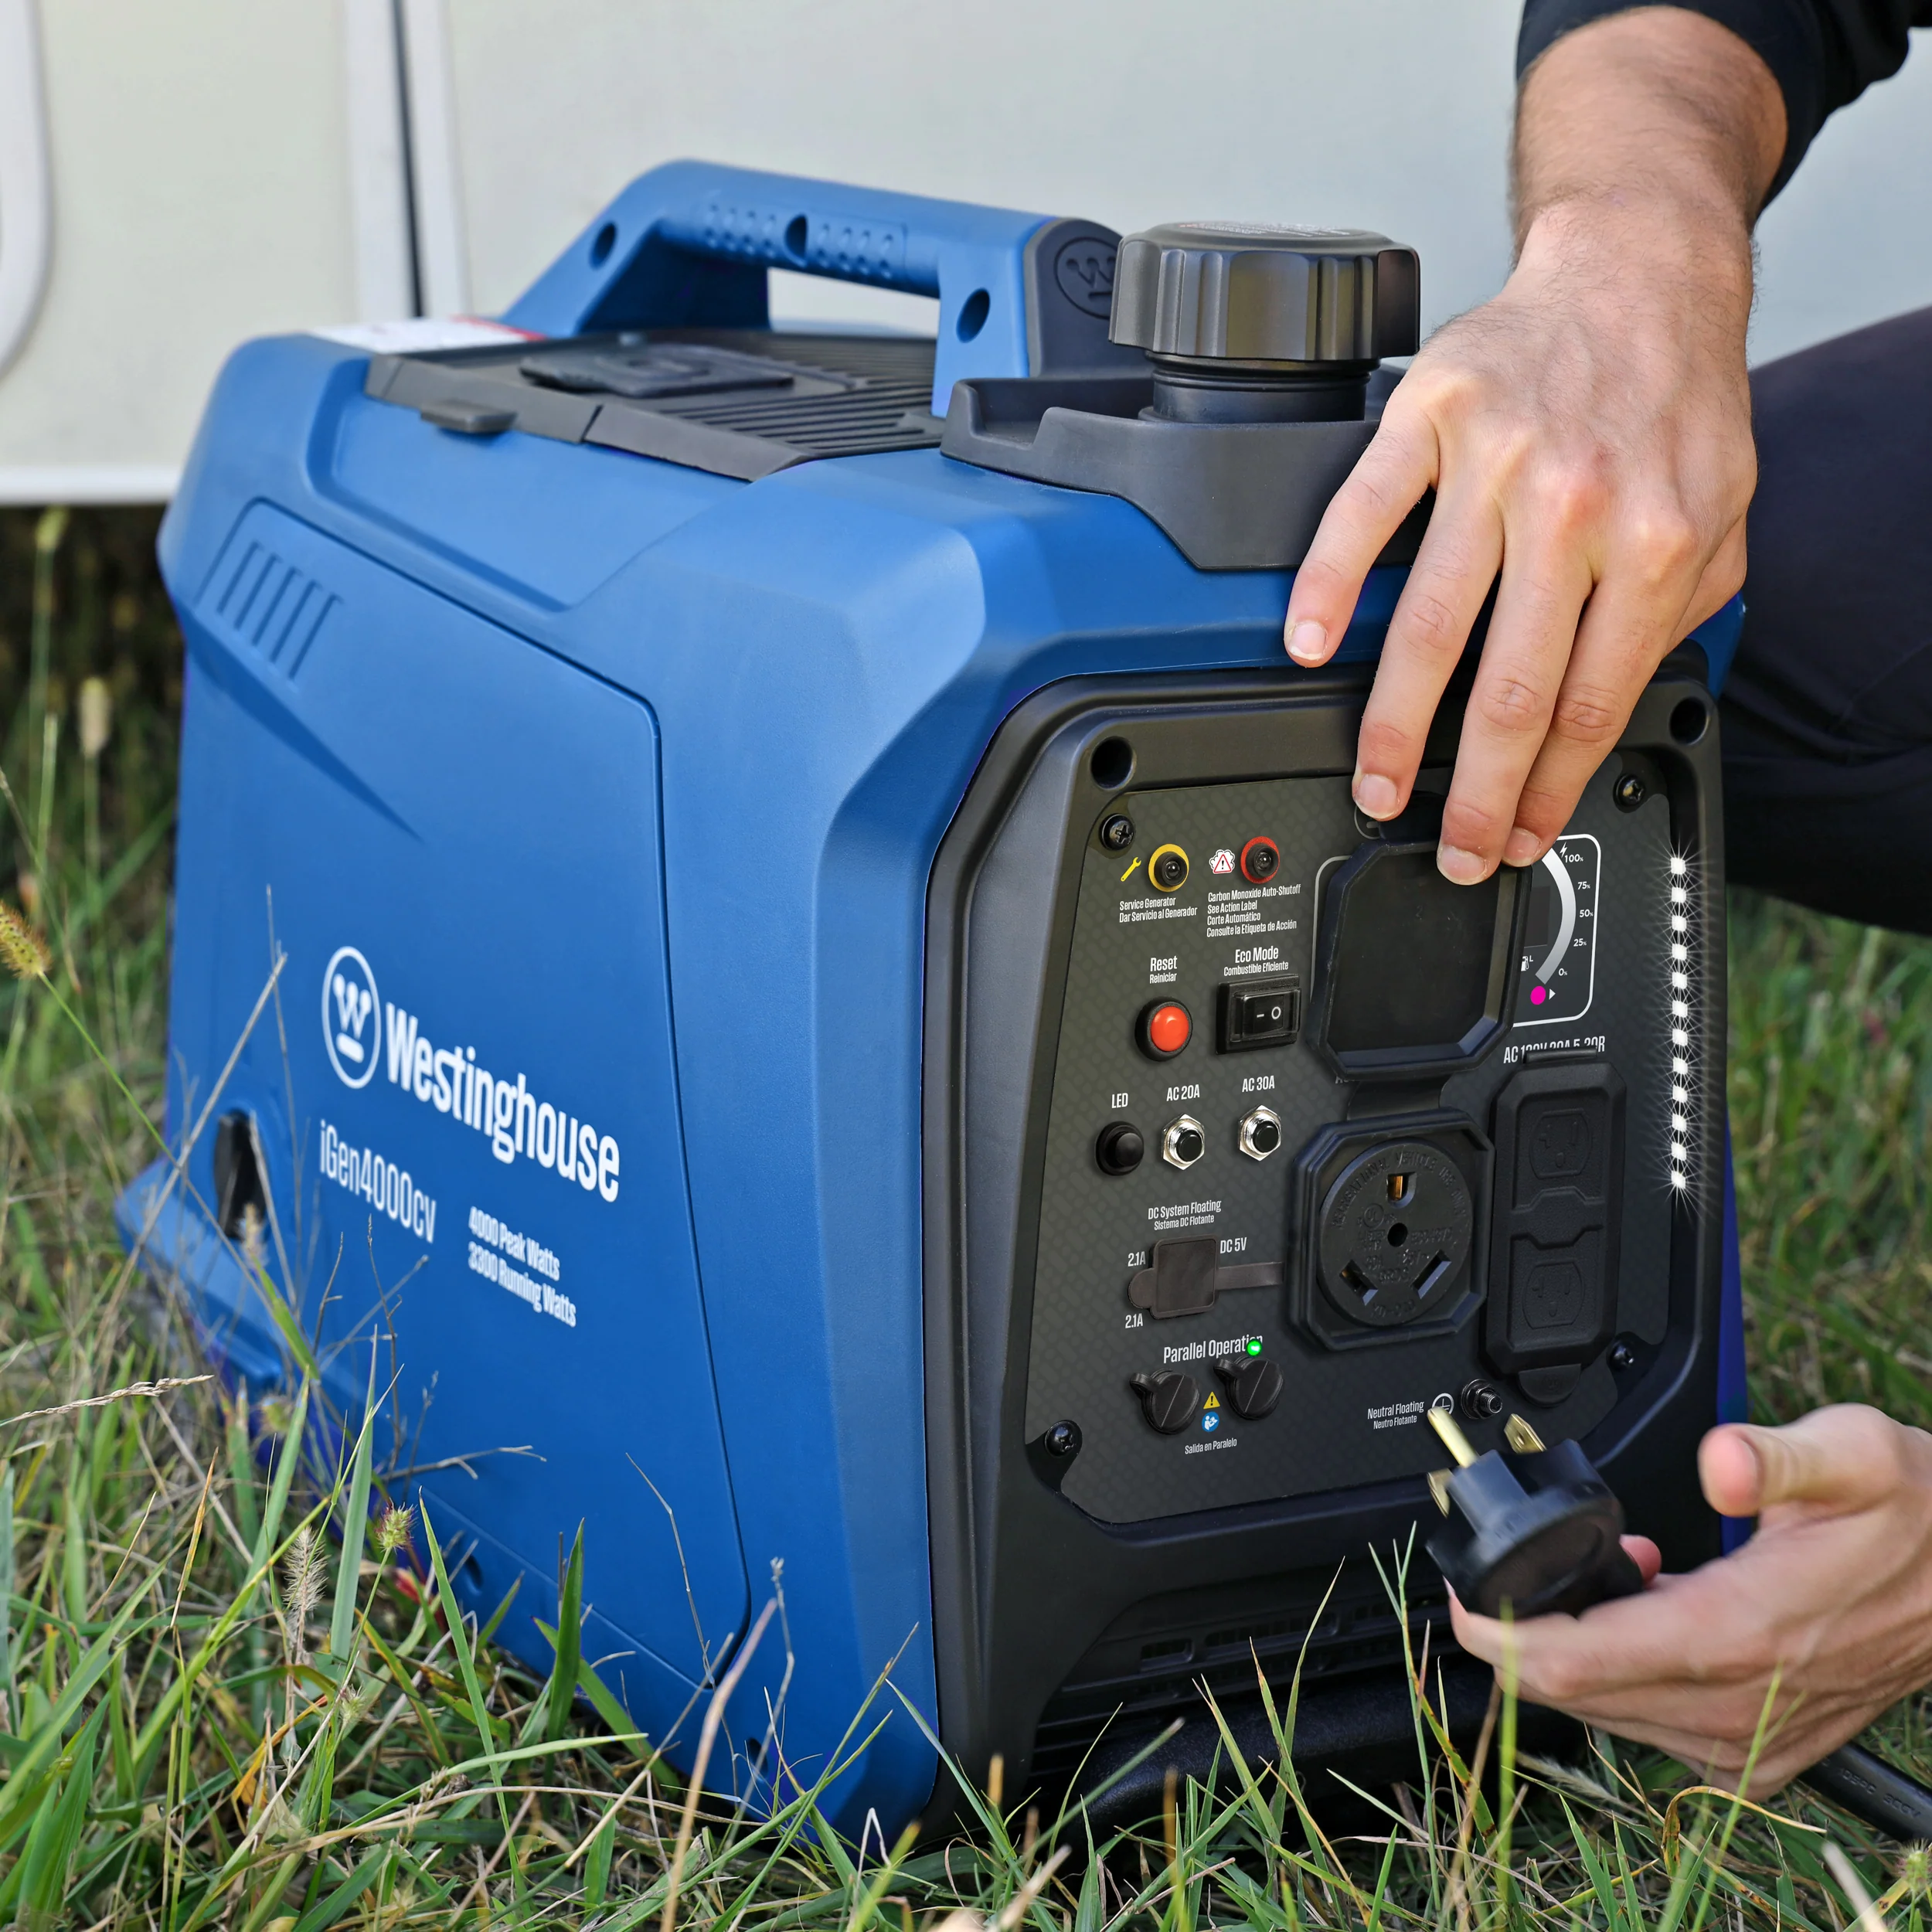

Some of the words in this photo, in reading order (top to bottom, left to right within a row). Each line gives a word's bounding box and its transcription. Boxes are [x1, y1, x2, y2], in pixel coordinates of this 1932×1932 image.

[1564, 854, 1583, 863] 100%
[1208, 892, 1230, 902] Carbon
[1231, 888, 1261, 900] Monoxide
[1262, 884, 1301, 896] Auto-Shutoff
[1577, 881, 1590, 889] 75%
[1119, 899, 1144, 911] Service
[1145, 896, 1176, 908] Generator
[1207, 904, 1219, 914] See
[1220, 902, 1240, 913] Action
[1241, 900, 1257, 911] Label
[1119, 913, 1131, 923] Dar
[1131, 910, 1157, 922] Servicio
[1158, 909, 1165, 919] al
[1165, 906, 1198, 918] Generador
[1207, 915, 1224, 926] Corte
[1225, 912, 1260, 923] Automático
[1580, 909, 1594, 917] 50%
[1206, 926, 1234, 937] Consulte
[1235, 925, 1240, 935] la
[1241, 923, 1267, 935] Etiqueta
[1267, 922, 1275, 931] de
[1276, 919, 1297, 930] Acción
[1573, 938, 1587, 947] 25%
[1235, 949, 1251, 963] Eco
[1253, 946, 1279, 961] Mode
[1150, 956, 1177, 972] Reset
[1224, 963, 1262, 976] Combustible
[1263, 961, 1288, 974] Eficiente
[1558, 968, 1568, 976] 0%
[1149, 973, 1177, 984] Reiniciar
[1503, 1046, 1519, 1063] AC
[1166, 1087, 1180, 1101] AC
[1181, 1084, 1200, 1100] 20A
[1242, 1078, 1255, 1093] AC
[1257, 1076, 1275, 1090] 30A
[386, 1002, 619, 1202] Westinghouse
[1111, 1093, 1128, 1108] LED
[1148, 1207, 1159, 1219] DC
[1160, 1203, 1189, 1219] System
[1191, 1200, 1222, 1216] Floating
[1154, 1219, 1179, 1230] Sistema
[1180, 1217, 1189, 1227] DC
[1190, 1214, 1214, 1226] Flotante
[468, 1206, 498, 1247] 4000
[499, 1222, 526, 1263] Peak
[526, 1237, 560, 1281] Watts
[1220, 1240, 1233, 1253] DC
[1234, 1237, 1247, 1252] 5V
[1128, 1251, 1146, 1267] 2.1A
[468, 1241, 498, 1282] 3300
[498, 1258, 542, 1313] Running
[543, 1283, 576, 1328] Watts
[1125, 1313, 1143, 1328] 2.1A
[1164, 1340, 1206, 1363] Parallel
[1367, 1404, 1394, 1419] Neutral
[1396, 1401, 1424, 1414] Floating
[1373, 1419, 1393, 1430] Neutro
[1394, 1415, 1417, 1427] Flotante
[1185, 1443, 1203, 1454] Salida
[1205, 1442, 1213, 1451] en
[1213, 1438, 1237, 1450] Paralelo
